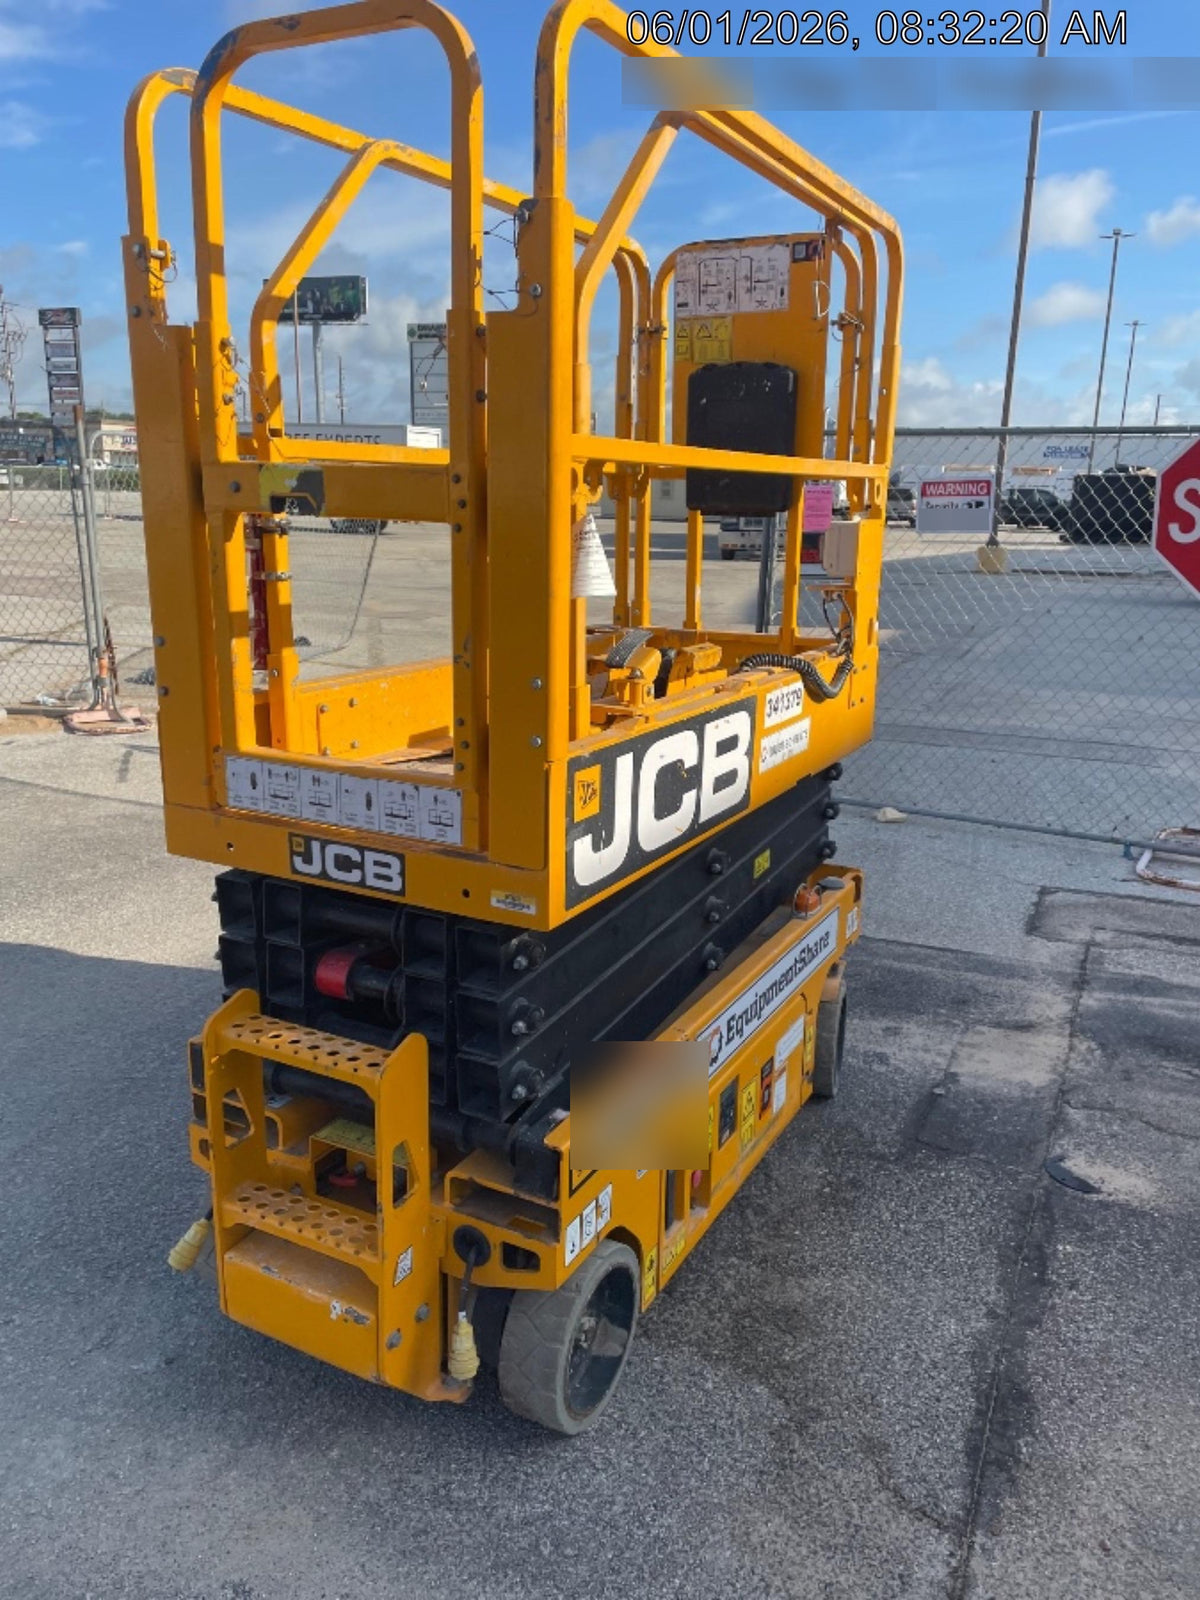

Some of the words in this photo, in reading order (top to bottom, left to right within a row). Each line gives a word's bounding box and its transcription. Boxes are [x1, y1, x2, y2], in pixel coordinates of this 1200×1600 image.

[925, 483, 988, 496] WARNING
[573, 711, 751, 887] JCB
[292, 840, 403, 892] JCB
[724, 931, 830, 1047] EquipmentShare
